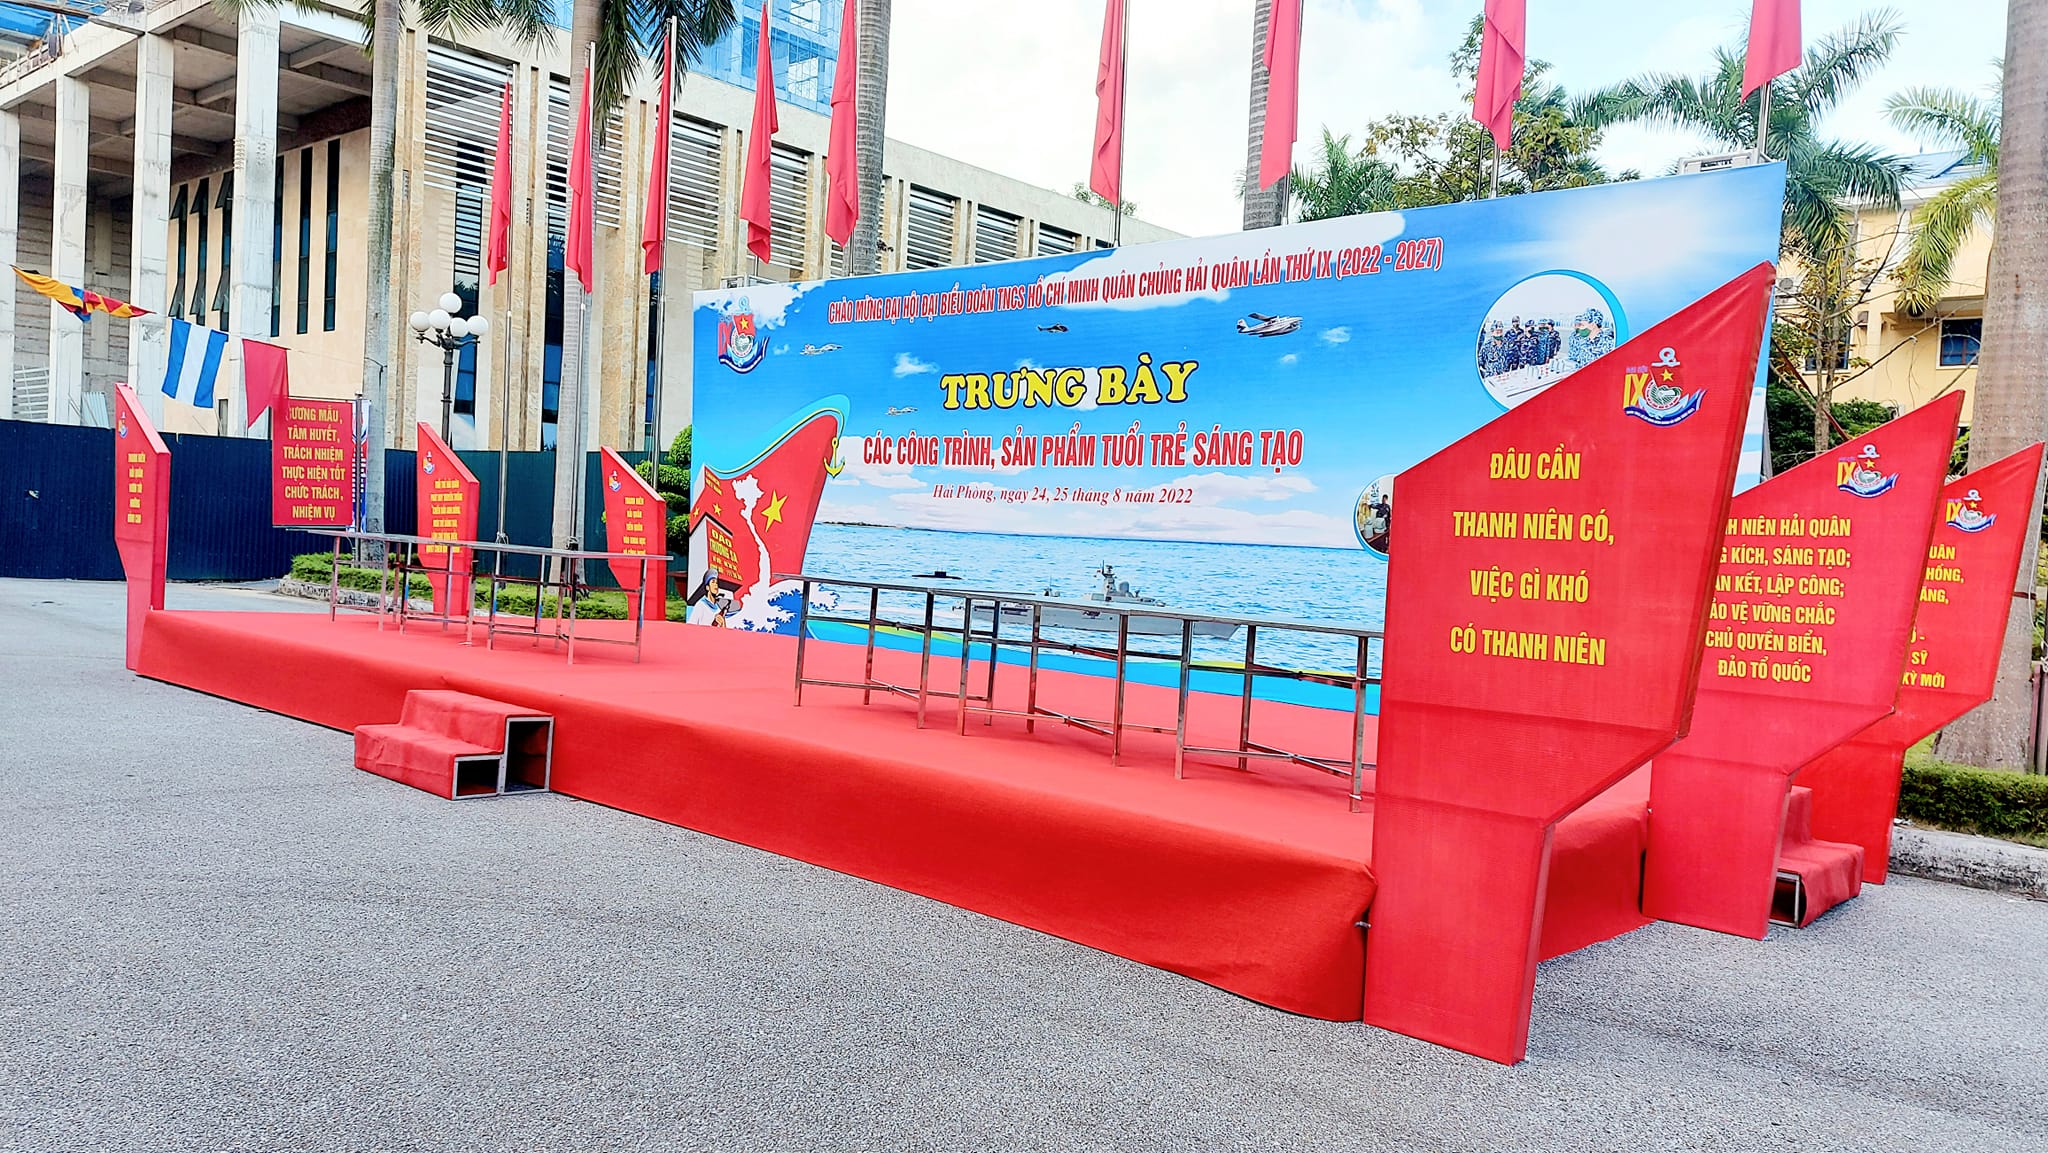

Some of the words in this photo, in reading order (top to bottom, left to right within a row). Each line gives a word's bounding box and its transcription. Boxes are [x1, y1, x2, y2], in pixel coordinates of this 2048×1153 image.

[828, 296, 853, 323] CHÀO
[855, 295, 882, 322] MỪNG
[884, 297, 902, 324] ĐẠI
[903, 291, 920, 323] HỘI
[921, 293, 939, 321] ĐẠI
[940, 282, 964, 315] BIỂU
[965, 284, 995, 313] ĐOÀN
[998, 285, 1025, 311] TNCS
[1045, 276, 1065, 306] CHÍ
[1067, 278, 1099, 304] MINH
[1102, 269, 1136, 303] QUÂN
[1139, 262, 1182, 296] CHỦNG
[1185, 257, 1208, 292] HẢI
[1211, 256, 1250, 292] QUÂN
[1252, 248, 1281, 285] LẦN
[1285, 247, 1315, 282] THỨ
[1316, 250, 1333, 278] IX
[1336, 244, 1381, 280] (2022
[1395, 237, 1443, 273] 2027)
[940, 367, 1088, 411] TRƯNG
[1095, 352, 1199, 407] BÀY
[1623, 373, 1649, 408] IX
[288, 424, 307, 440] TÂM
[310, 424, 340, 443] HUYẾT,
[283, 444, 312, 460] TRÁCH
[314, 446, 344, 463] NHIỆM
[863, 430, 893, 465] CÁC
[897, 431, 940, 466] CÔNG
[943, 431, 996, 470] TRÌNH,
[1001, 426, 1037, 467] SẢN
[1042, 422, 1096, 467] PHẨM
[1102, 421, 1145, 467] TUỔI
[1150, 421, 1187, 466] TRẺ
[1192, 425, 1254, 466] SÁNG
[1260, 430, 1304, 474] TẠO
[282, 466, 305, 482] THỰC
[307, 466, 328, 482] HIỆN
[330, 463, 346, 481] TỐT
[1490, 447, 1531, 480] ĐÂU
[1537, 443, 1581, 480] CẦN
[1836, 461, 1857, 486] IX
[285, 482, 309, 499] CHỨC
[956, 484, 997, 503] Phòng,
[1000, 488, 1029, 504] ngày
[1031, 487, 1050, 504] 24,
[1053, 487, 1069, 502] 25
[1072, 486, 1109, 506] tháng
[1112, 488, 1121, 503] 8
[1125, 488, 1155, 504] năm
[1158, 488, 1194, 504] 2022
[292, 503, 322, 520] NHIỆM
[324, 505, 335, 521] VỤ
[1945, 501, 1962, 522] IX
[1453, 511, 1517, 538] THANH
[1523, 508, 1573, 541] NIÊN
[1579, 509, 1615, 545] CÓ,
[1741, 515, 1776, 536] NIÊN
[1779, 513, 1805, 536] HẢI
[1808, 515, 1851, 538] QUÂN
[1731, 544, 1769, 566] KÍCH,
[1772, 545, 1813, 566] SÁNG
[1818, 548, 1851, 569] TẠO;
[1929, 544, 1956, 560] UÂN
[1470, 566, 1514, 603] VIỆC
[1520, 568, 1540, 600] GÌ
[1546, 570, 1589, 603] KHÓ
[1735, 571, 1763, 595] KẾT,
[1767, 573, 1795, 597] LẬP
[1798, 574, 1845, 598] CÔNG;
[1926, 563, 1964, 584] HỐNG,
[1709, 597, 1728, 620] ẢO
[1731, 600, 1748, 624] VỆ
[1752, 601, 1791, 623] VỮNG
[1795, 601, 1836, 625] CHẮC
[1450, 623, 1476, 653] CÓ
[1482, 629, 1547, 660] THANH
[1554, 632, 1606, 666] NIÊN
[1705, 626, 1733, 648] CHỦ
[1737, 628, 1784, 651] QUYỀN
[1788, 629, 1827, 656] BIỂN,
[1718, 655, 1747, 678] ĐẢO
[1750, 656, 1768, 679] TỔ
[1772, 658, 1811, 682] QUỐC
[1911, 650, 1928, 665] SỸ
[1920, 672, 1945, 688] MỚI
